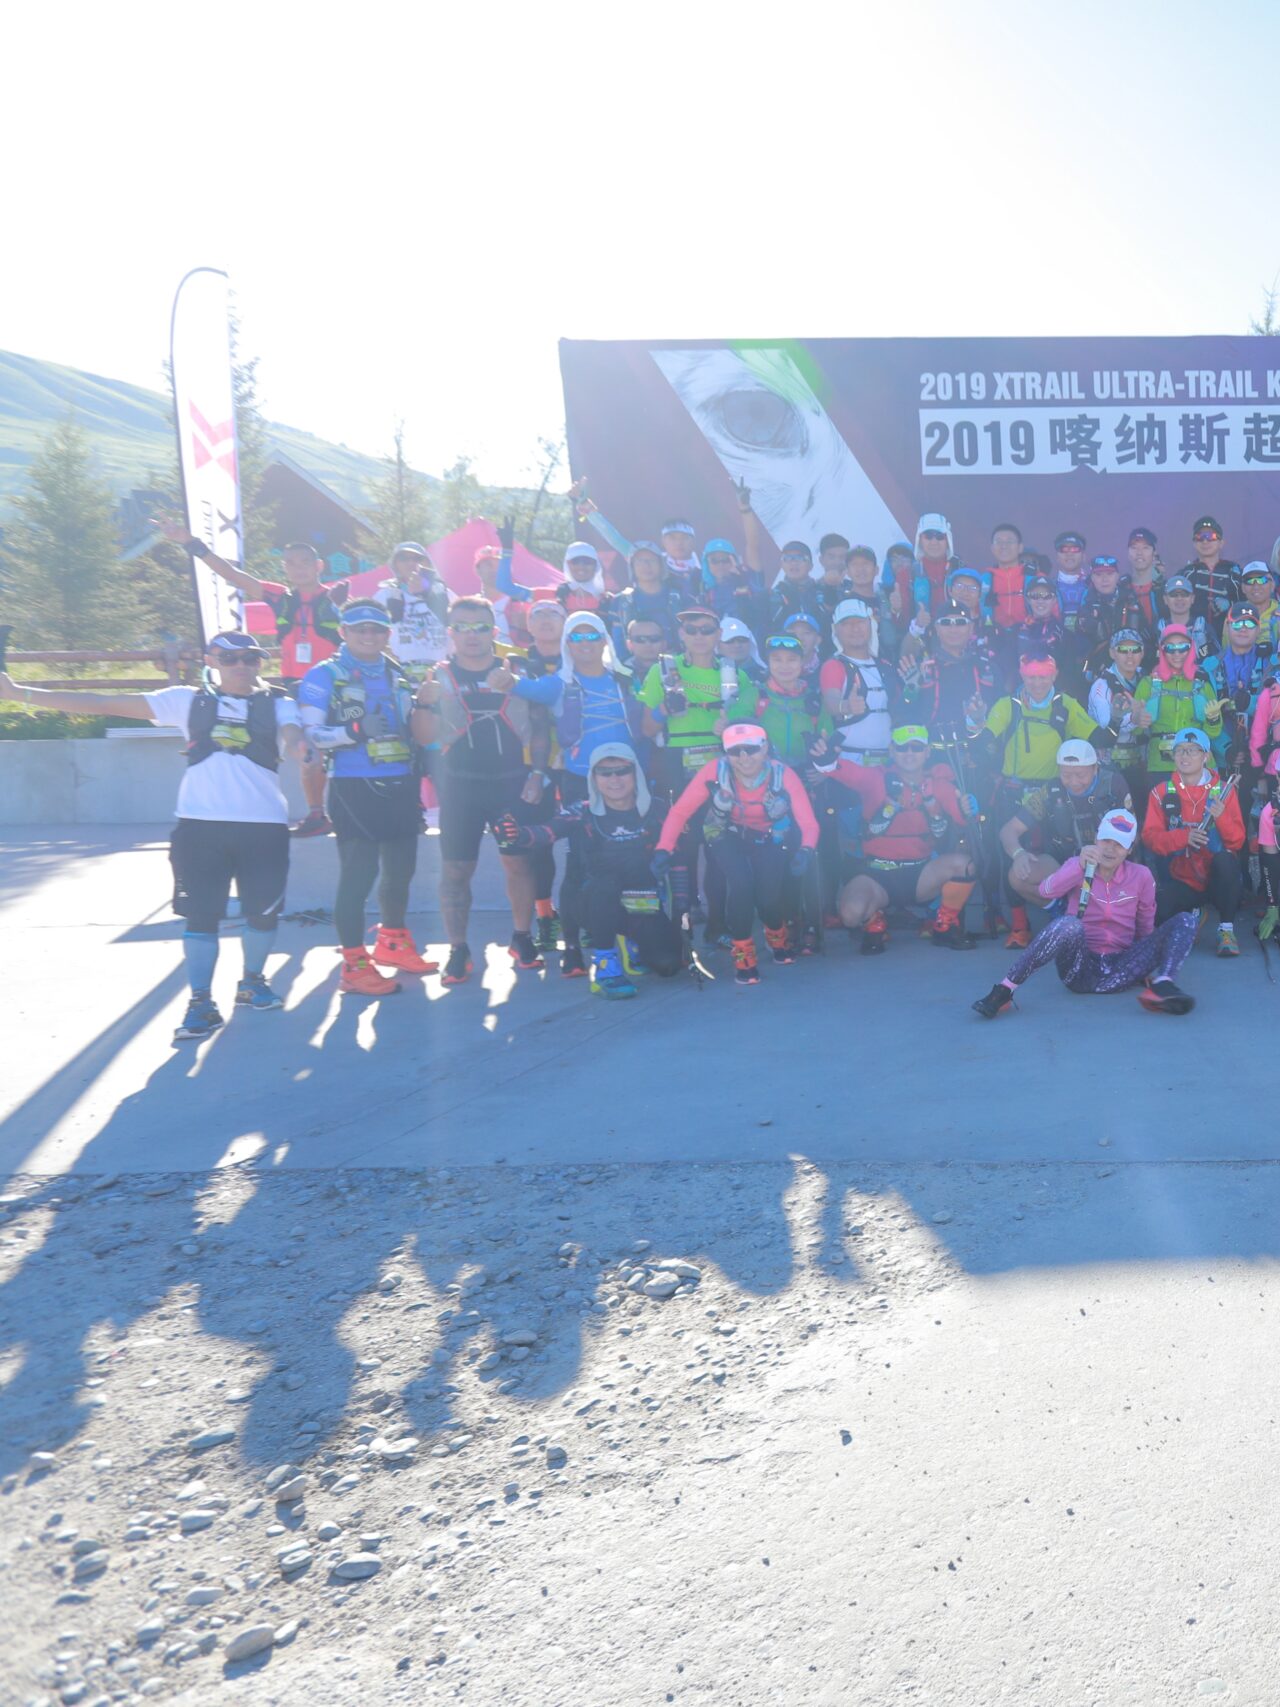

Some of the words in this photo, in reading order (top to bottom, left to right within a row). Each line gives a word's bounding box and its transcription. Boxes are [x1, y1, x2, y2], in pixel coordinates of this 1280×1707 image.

[920, 371, 986, 401] 2019
[993, 371, 1085, 400] XTRAIL
[1093, 370, 1258, 399] ULTRA-TRAIL
